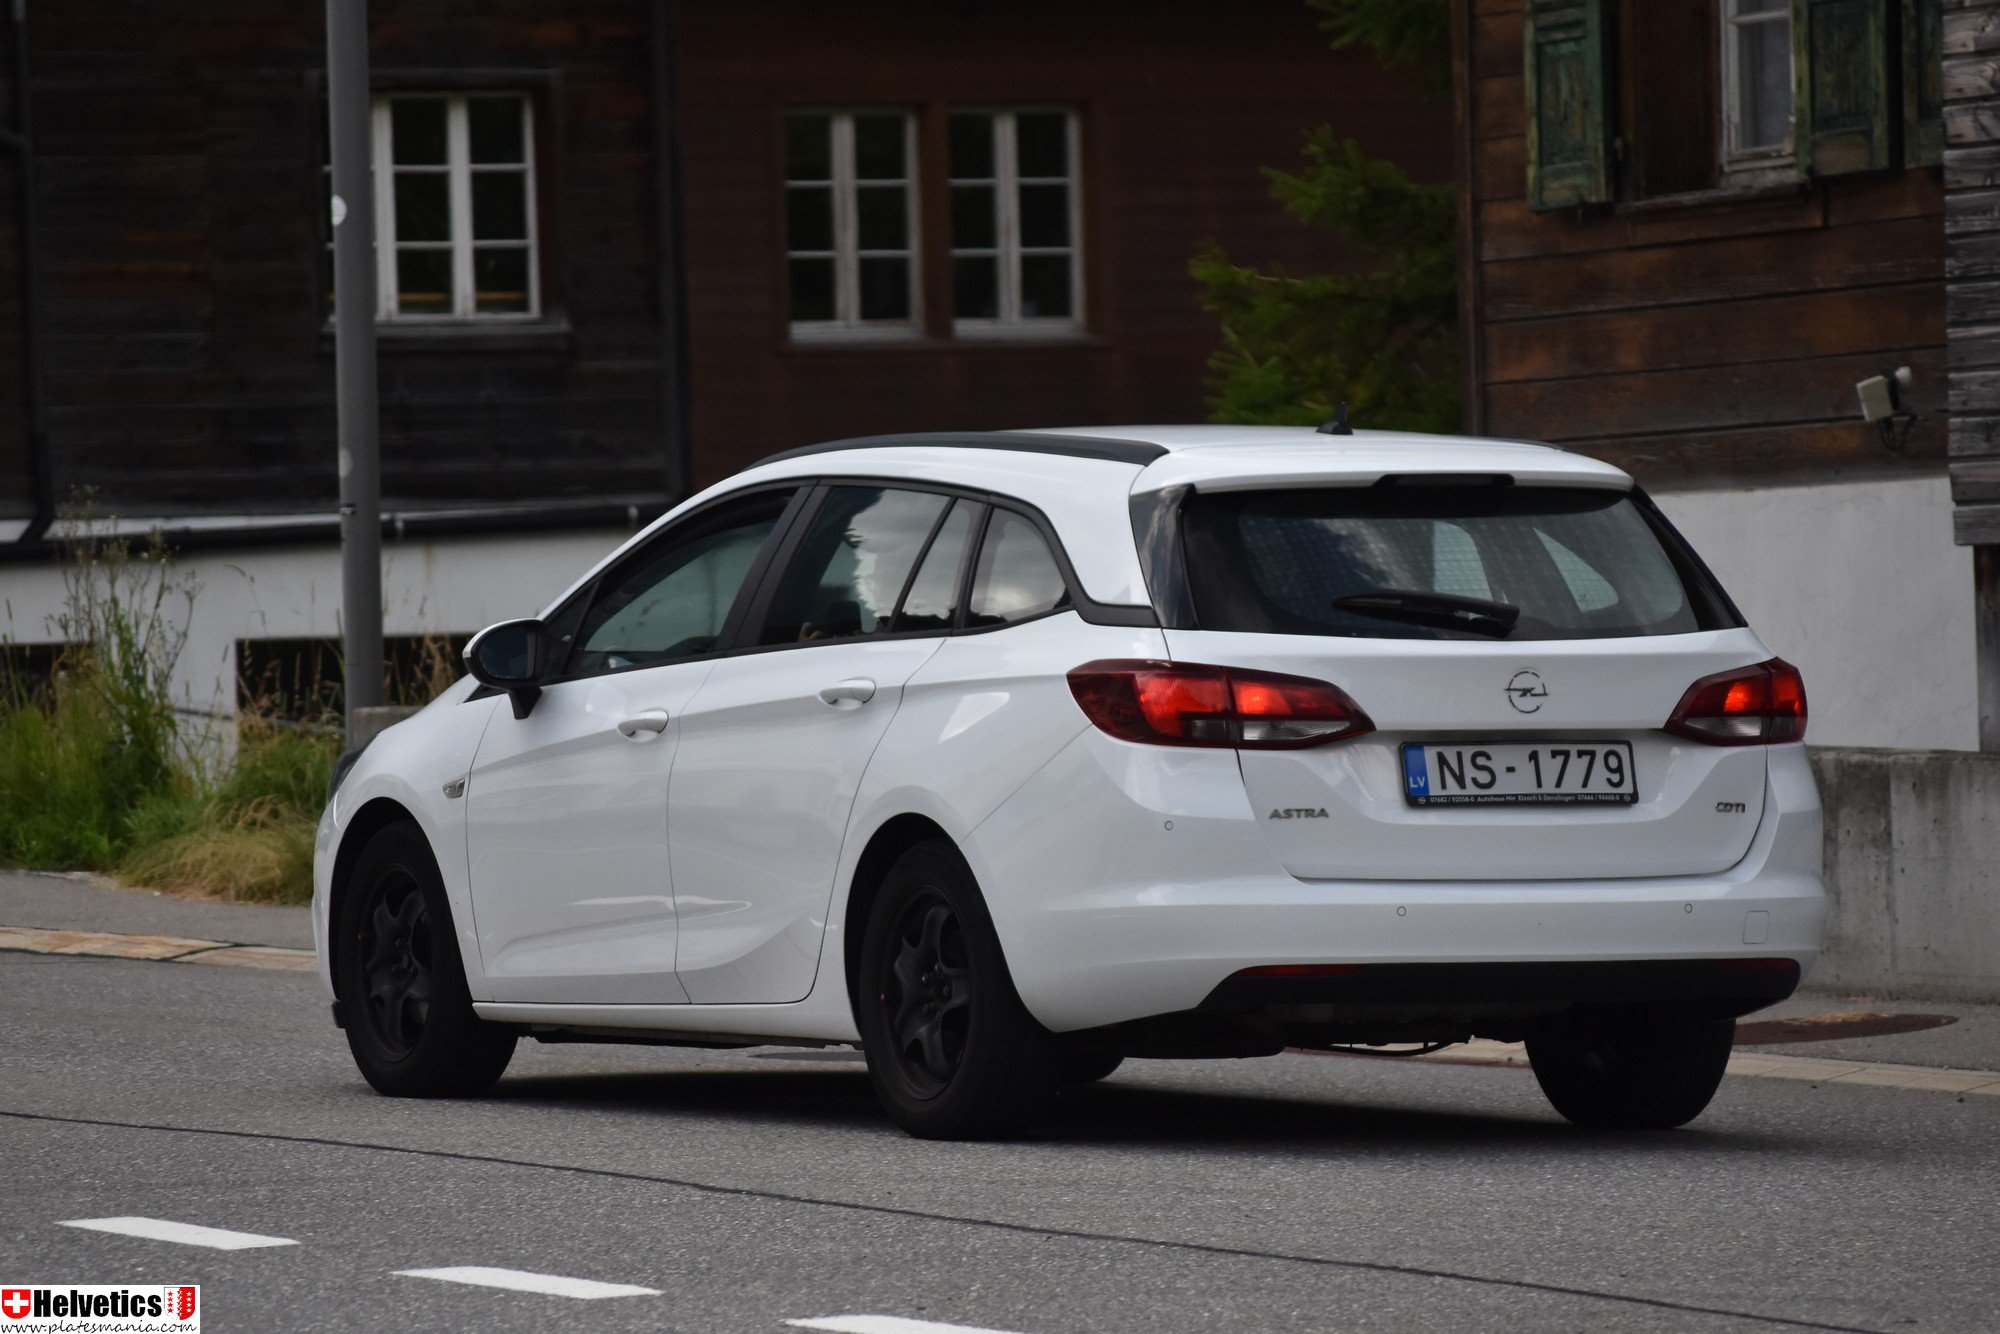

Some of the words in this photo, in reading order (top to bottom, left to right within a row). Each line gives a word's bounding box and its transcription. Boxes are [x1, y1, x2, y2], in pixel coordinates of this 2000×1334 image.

[1436, 749, 1625, 790] NS-1779
[1409, 776, 1427, 788] LV
[1269, 808, 1329, 820] ASTRA
